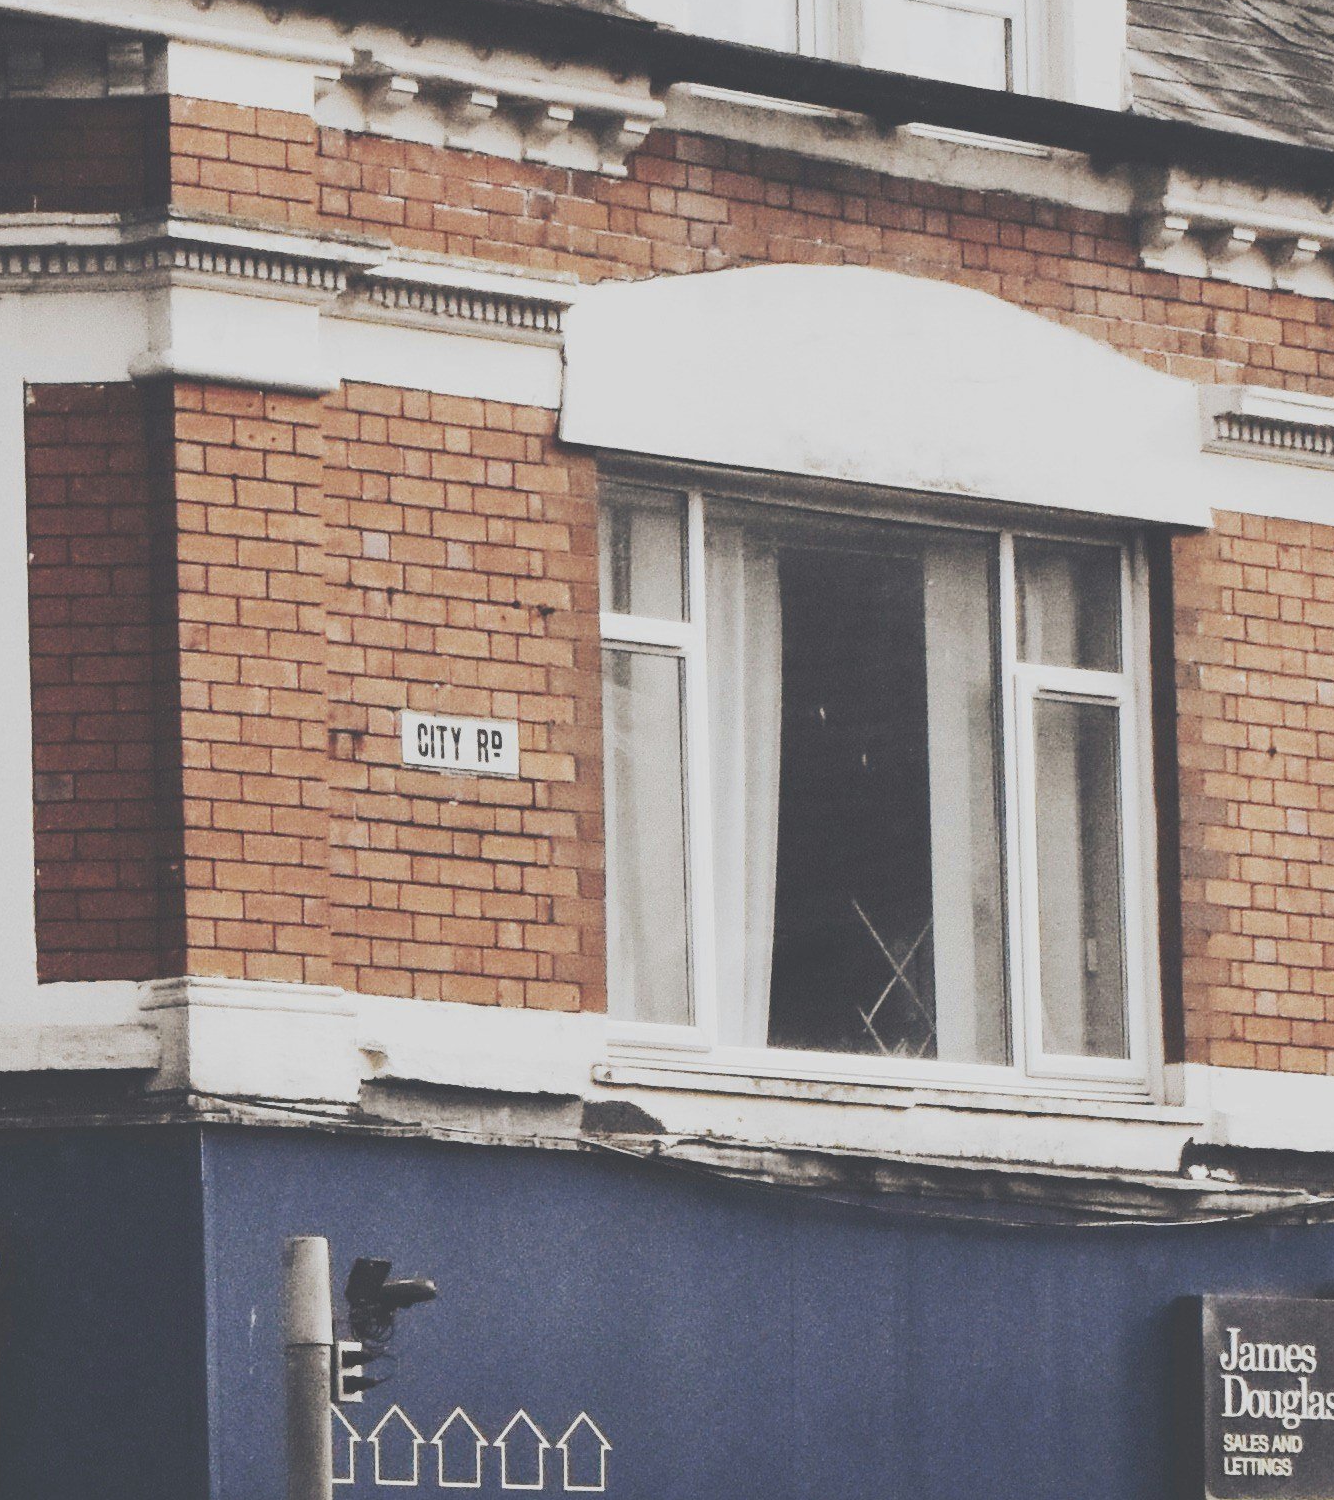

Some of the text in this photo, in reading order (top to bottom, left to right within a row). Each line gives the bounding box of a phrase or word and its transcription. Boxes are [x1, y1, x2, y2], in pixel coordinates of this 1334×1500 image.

[417, 723, 461, 760] CITY
[1219, 1327, 1317, 1373] James
[1223, 1434, 1303, 1453] SALES AND
[1223, 1457, 1293, 1476] LETTINGS
